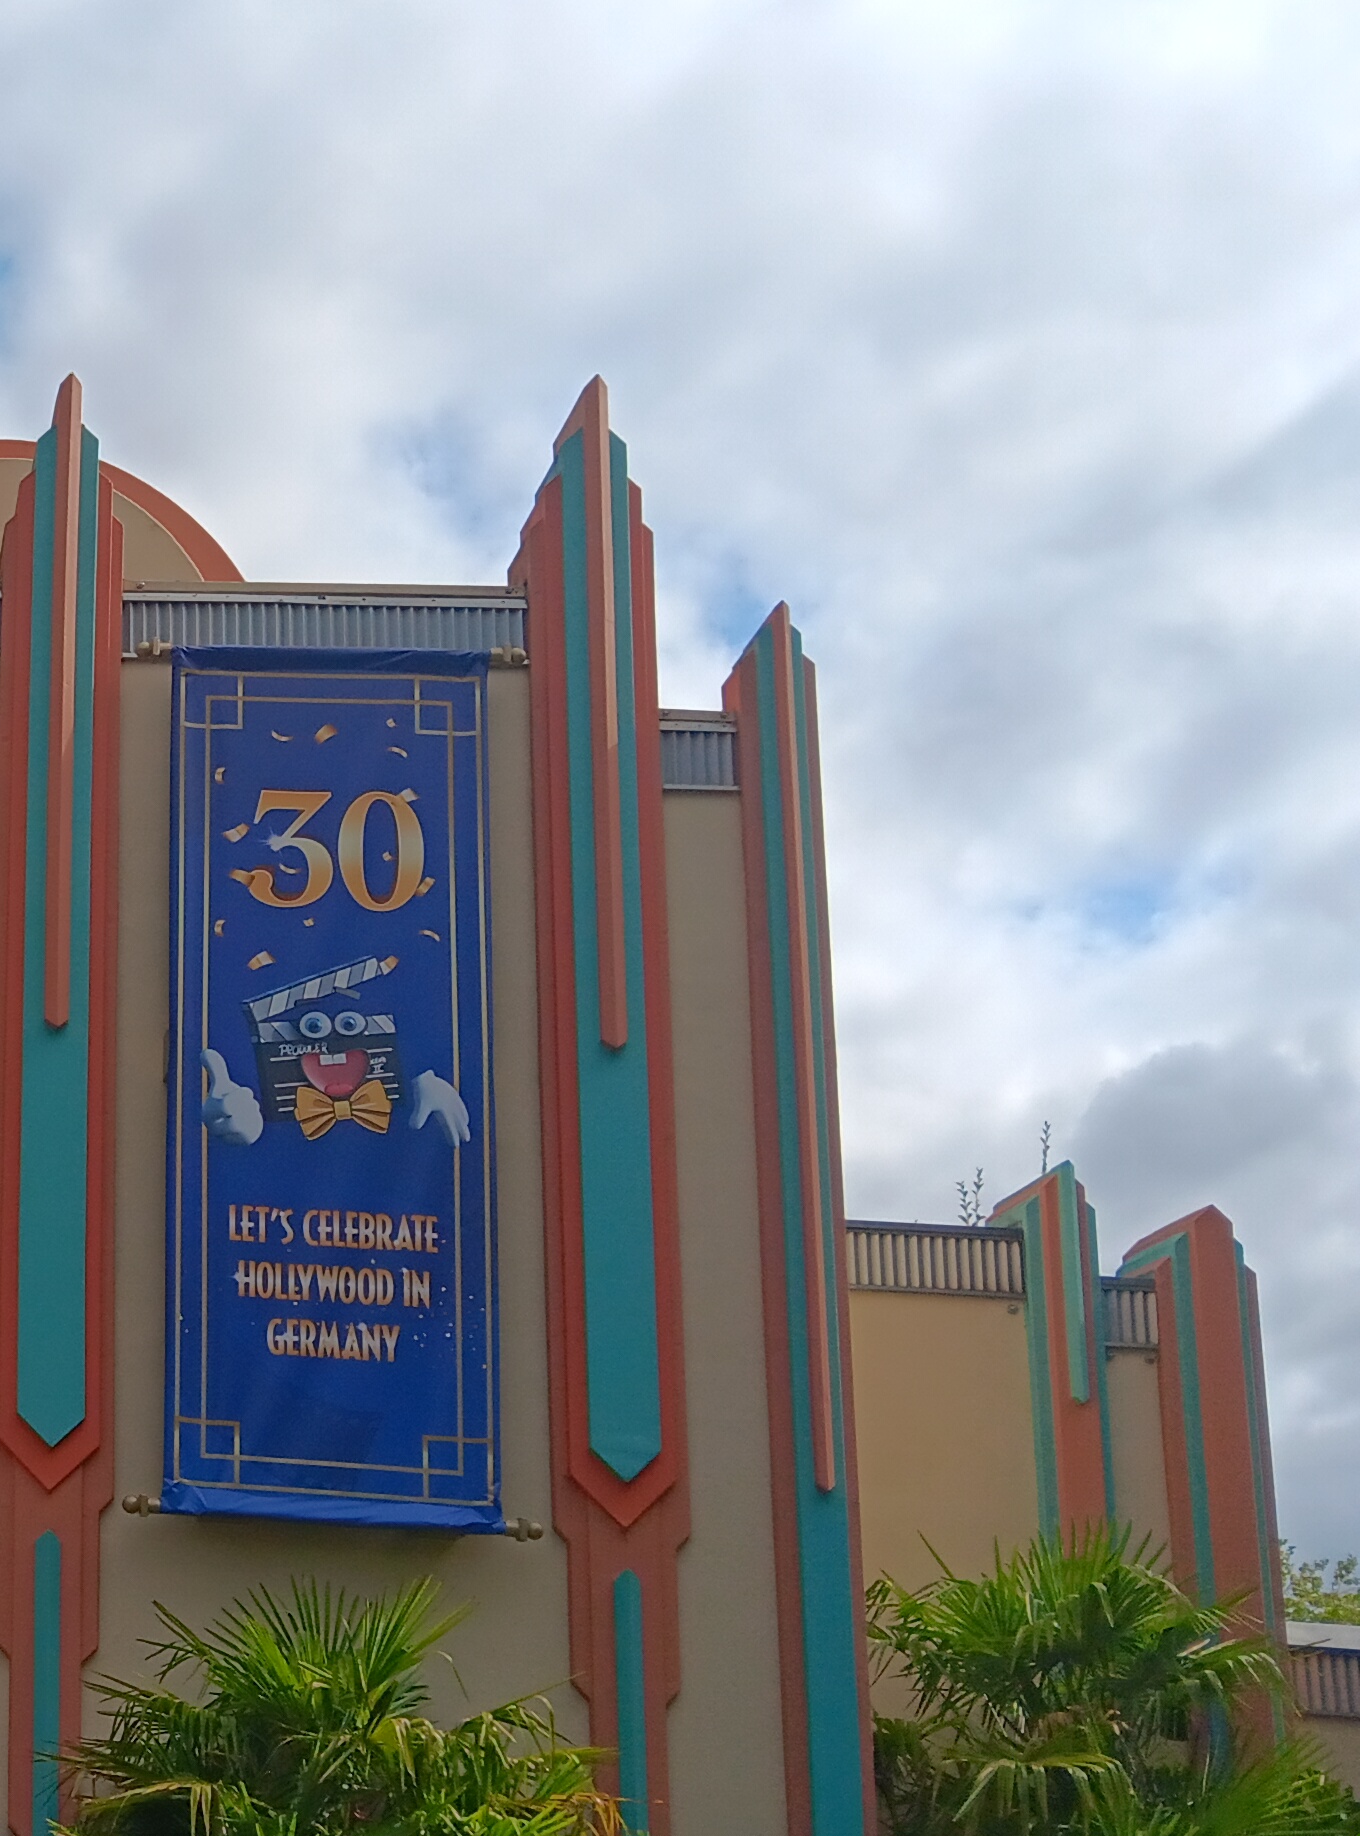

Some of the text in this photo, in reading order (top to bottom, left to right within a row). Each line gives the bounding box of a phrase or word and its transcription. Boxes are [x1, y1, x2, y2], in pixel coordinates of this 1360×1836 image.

[248, 789, 425, 912] 30
[228, 1204, 439, 1254] LET'S CELEBRATE
[237, 1259, 430, 1309] HOLLYWOOD IN
[266, 1318, 400, 1362] GERMANY
